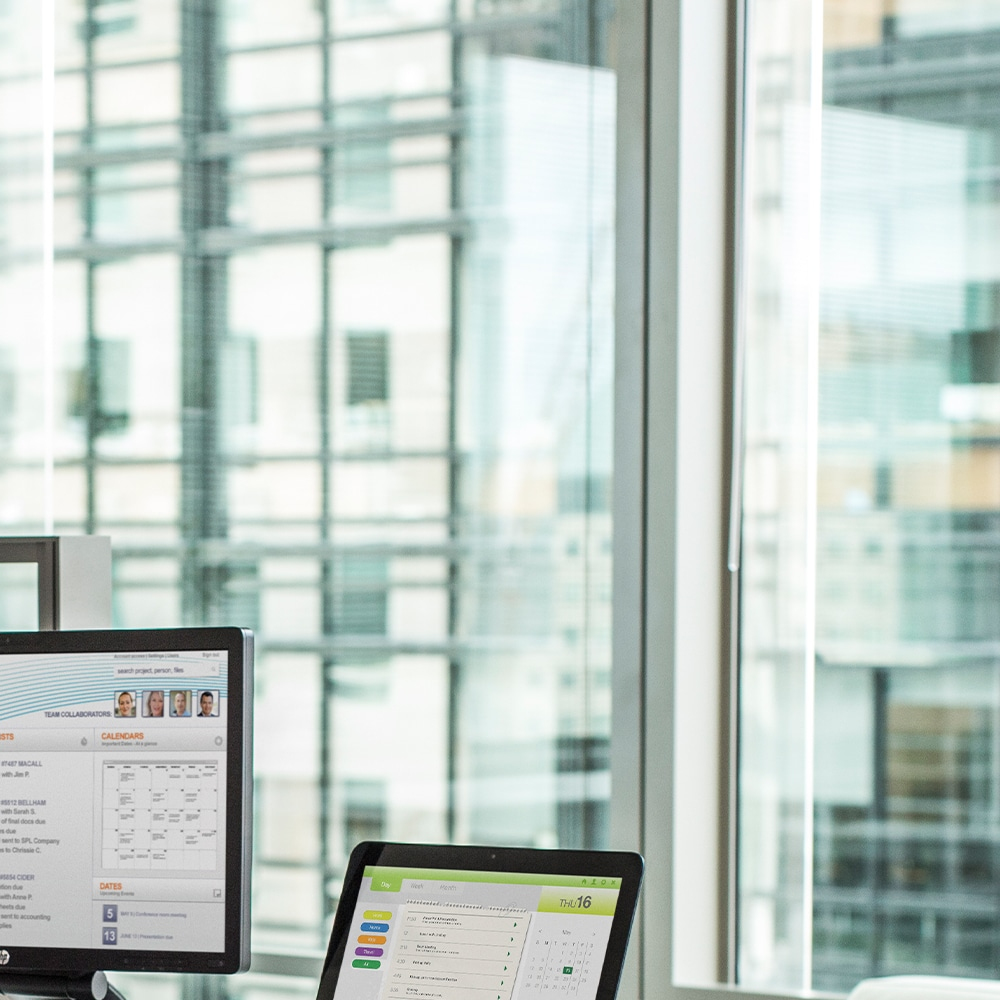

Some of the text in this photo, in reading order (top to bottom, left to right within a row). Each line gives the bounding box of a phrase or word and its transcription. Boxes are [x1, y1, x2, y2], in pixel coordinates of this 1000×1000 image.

[101, 732, 144, 740] CALENDARS
[34, 838, 60, 846] Company
[100, 882, 122, 890] DATES
[106, 908, 113, 918] 5
[104, 931, 116, 941] 13
